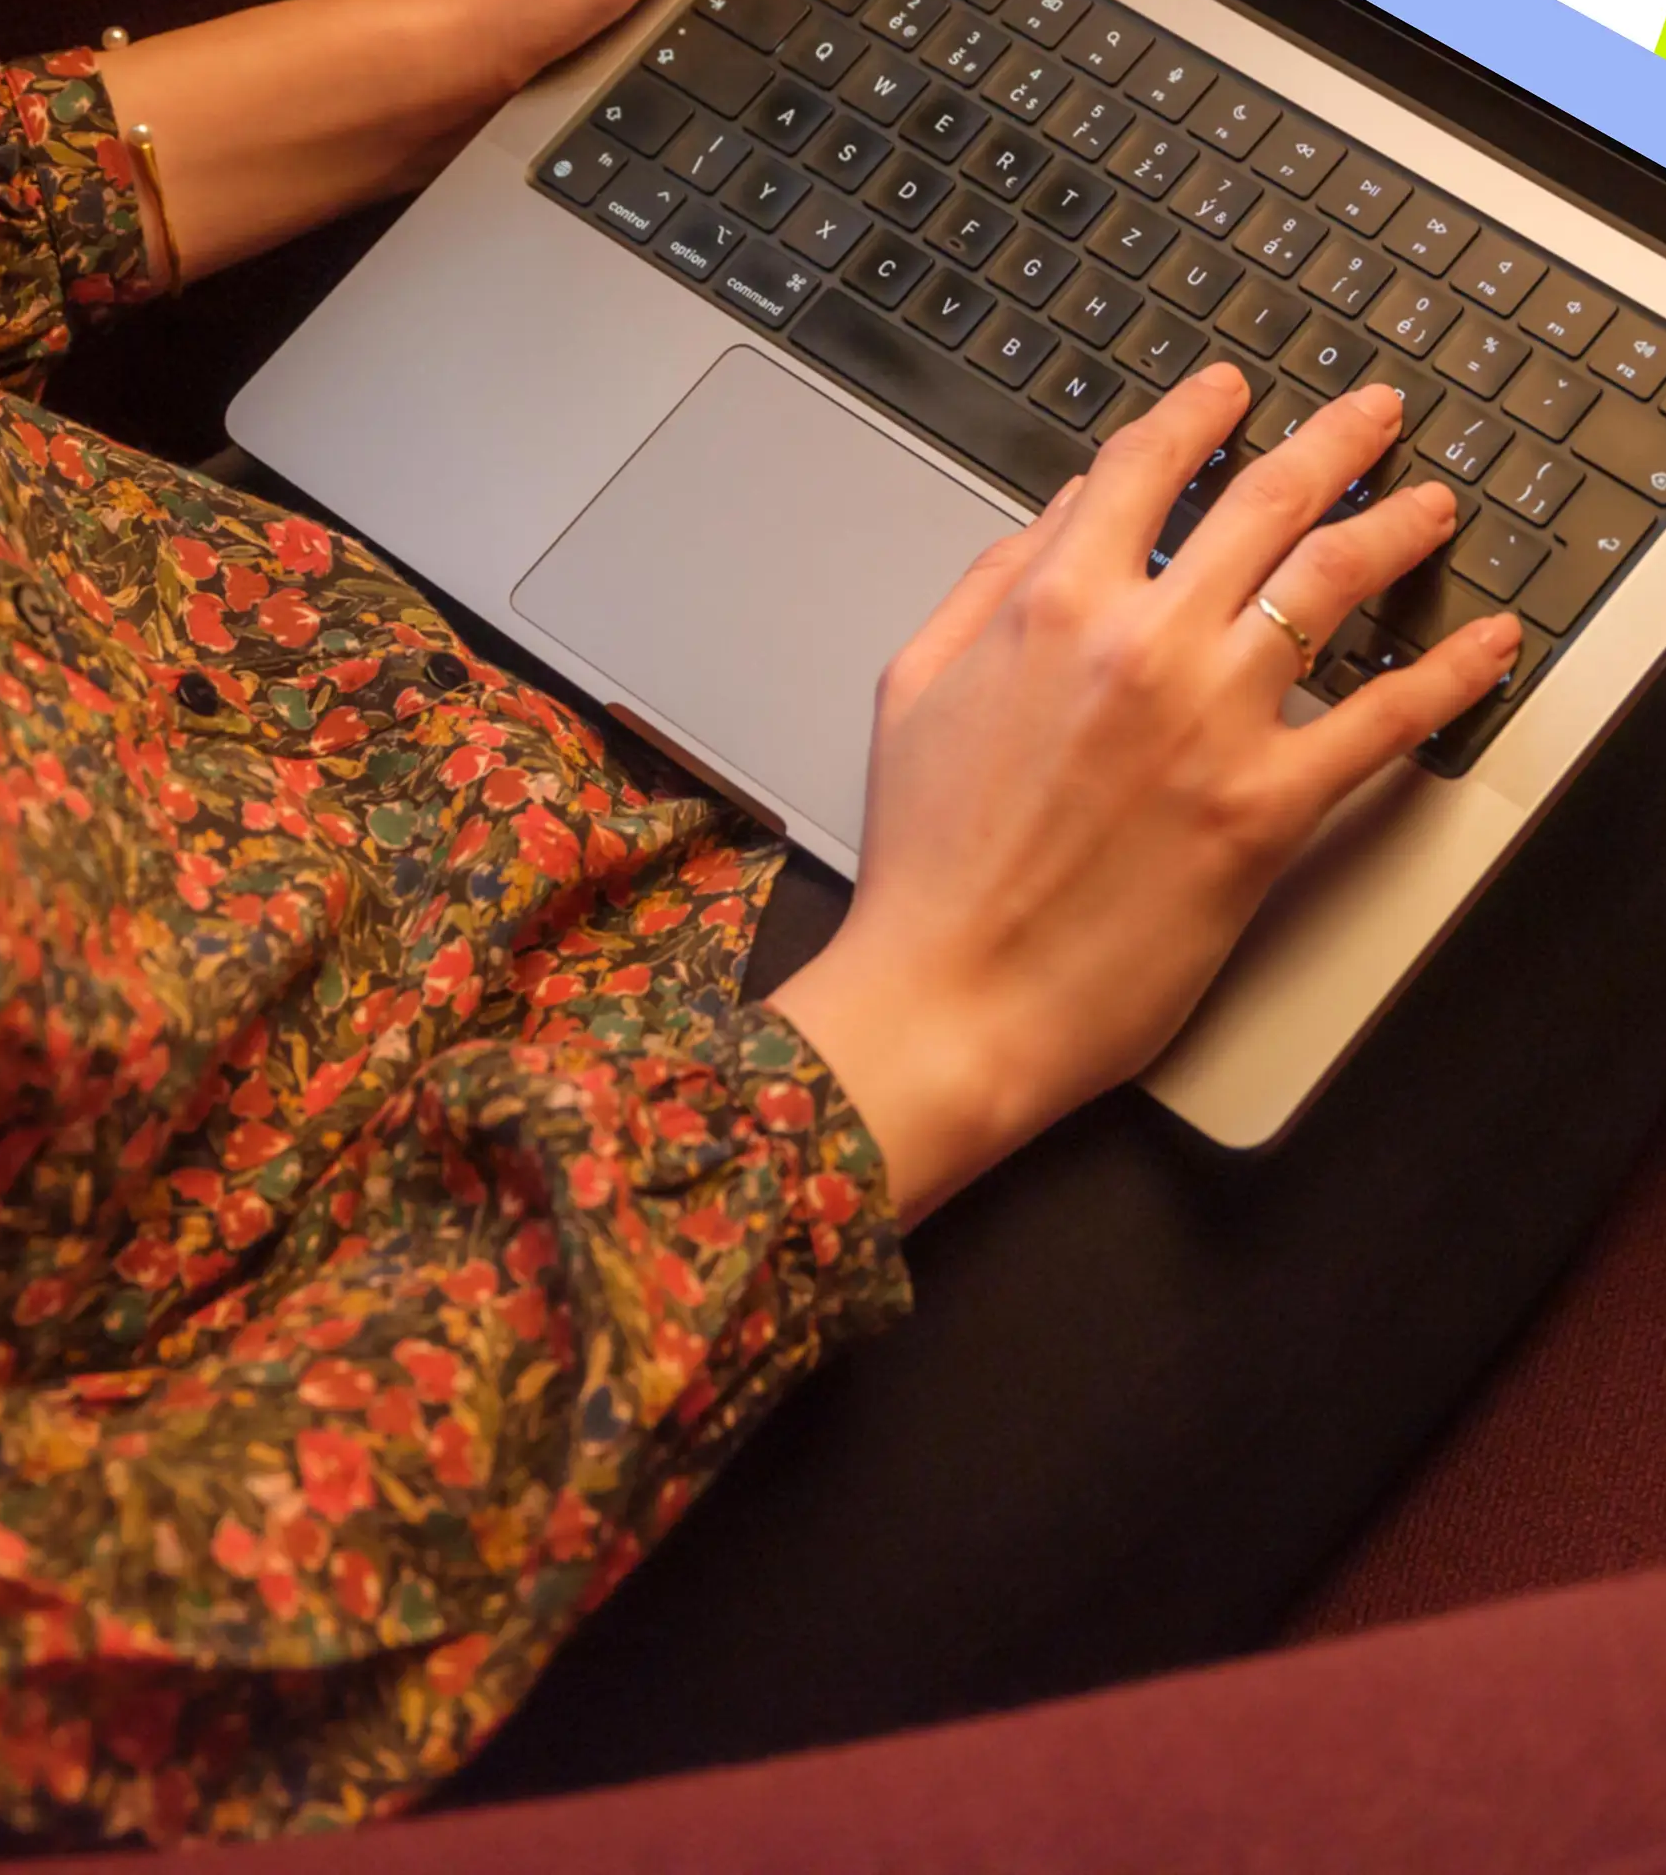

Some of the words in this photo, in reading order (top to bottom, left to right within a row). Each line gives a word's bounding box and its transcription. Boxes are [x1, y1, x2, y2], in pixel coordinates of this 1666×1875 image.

[1027, 17, 1041, 29] F3
[967, 31, 981, 44] 3
[815, 42, 833, 62] Q
[1089, 53, 1103, 65] F4
[1029, 69, 1042, 81] 4
[874, 76, 897, 97] W
[1151, 90, 1166, 103] F5
[777, 109, 795, 125] A
[1090, 105, 1105, 119] 5
[935, 115, 954, 133] E
[1215, 127, 1229, 140] F6
[838, 144, 857, 162] S
[1153, 142, 1168, 156] 6
[598, 152, 613, 168] fn
[996, 151, 1015, 170] R
[759, 182, 777, 200] Y
[898, 181, 917, 200] D
[1218, 180, 1232, 192] 7
[1061, 189, 1079, 207] T
[608, 201, 651, 231] control
[1345, 204, 1360, 216] F8
[816, 220, 836, 239] X
[961, 219, 980, 235] F
[1282, 219, 1297, 232] 8
[1121, 228, 1142, 247] Z
[670, 240, 708, 269] option
[1412, 242, 1426, 254] F9
[878, 260, 897, 278] C
[1023, 258, 1042, 277] G
[1348, 257, 1363, 271] 9
[1187, 266, 1207, 285] U
[727, 277, 784, 317] command
[1477, 281, 1497, 296] F10
[941, 297, 960, 316] V
[1085, 296, 1107, 317] H
[1396, 317, 1415, 334] é
[1547, 322, 1565, 336] F11
[1002, 338, 1022, 357] B
[1151, 341, 1170, 355] J
[1483, 336, 1499, 353] %
[1318, 347, 1338, 365] O
[1617, 363, 1636, 379] F12
[1065, 377, 1087, 398] N
[1284, 419, 1298, 438] L
[1209, 449, 1226, 467] ?
